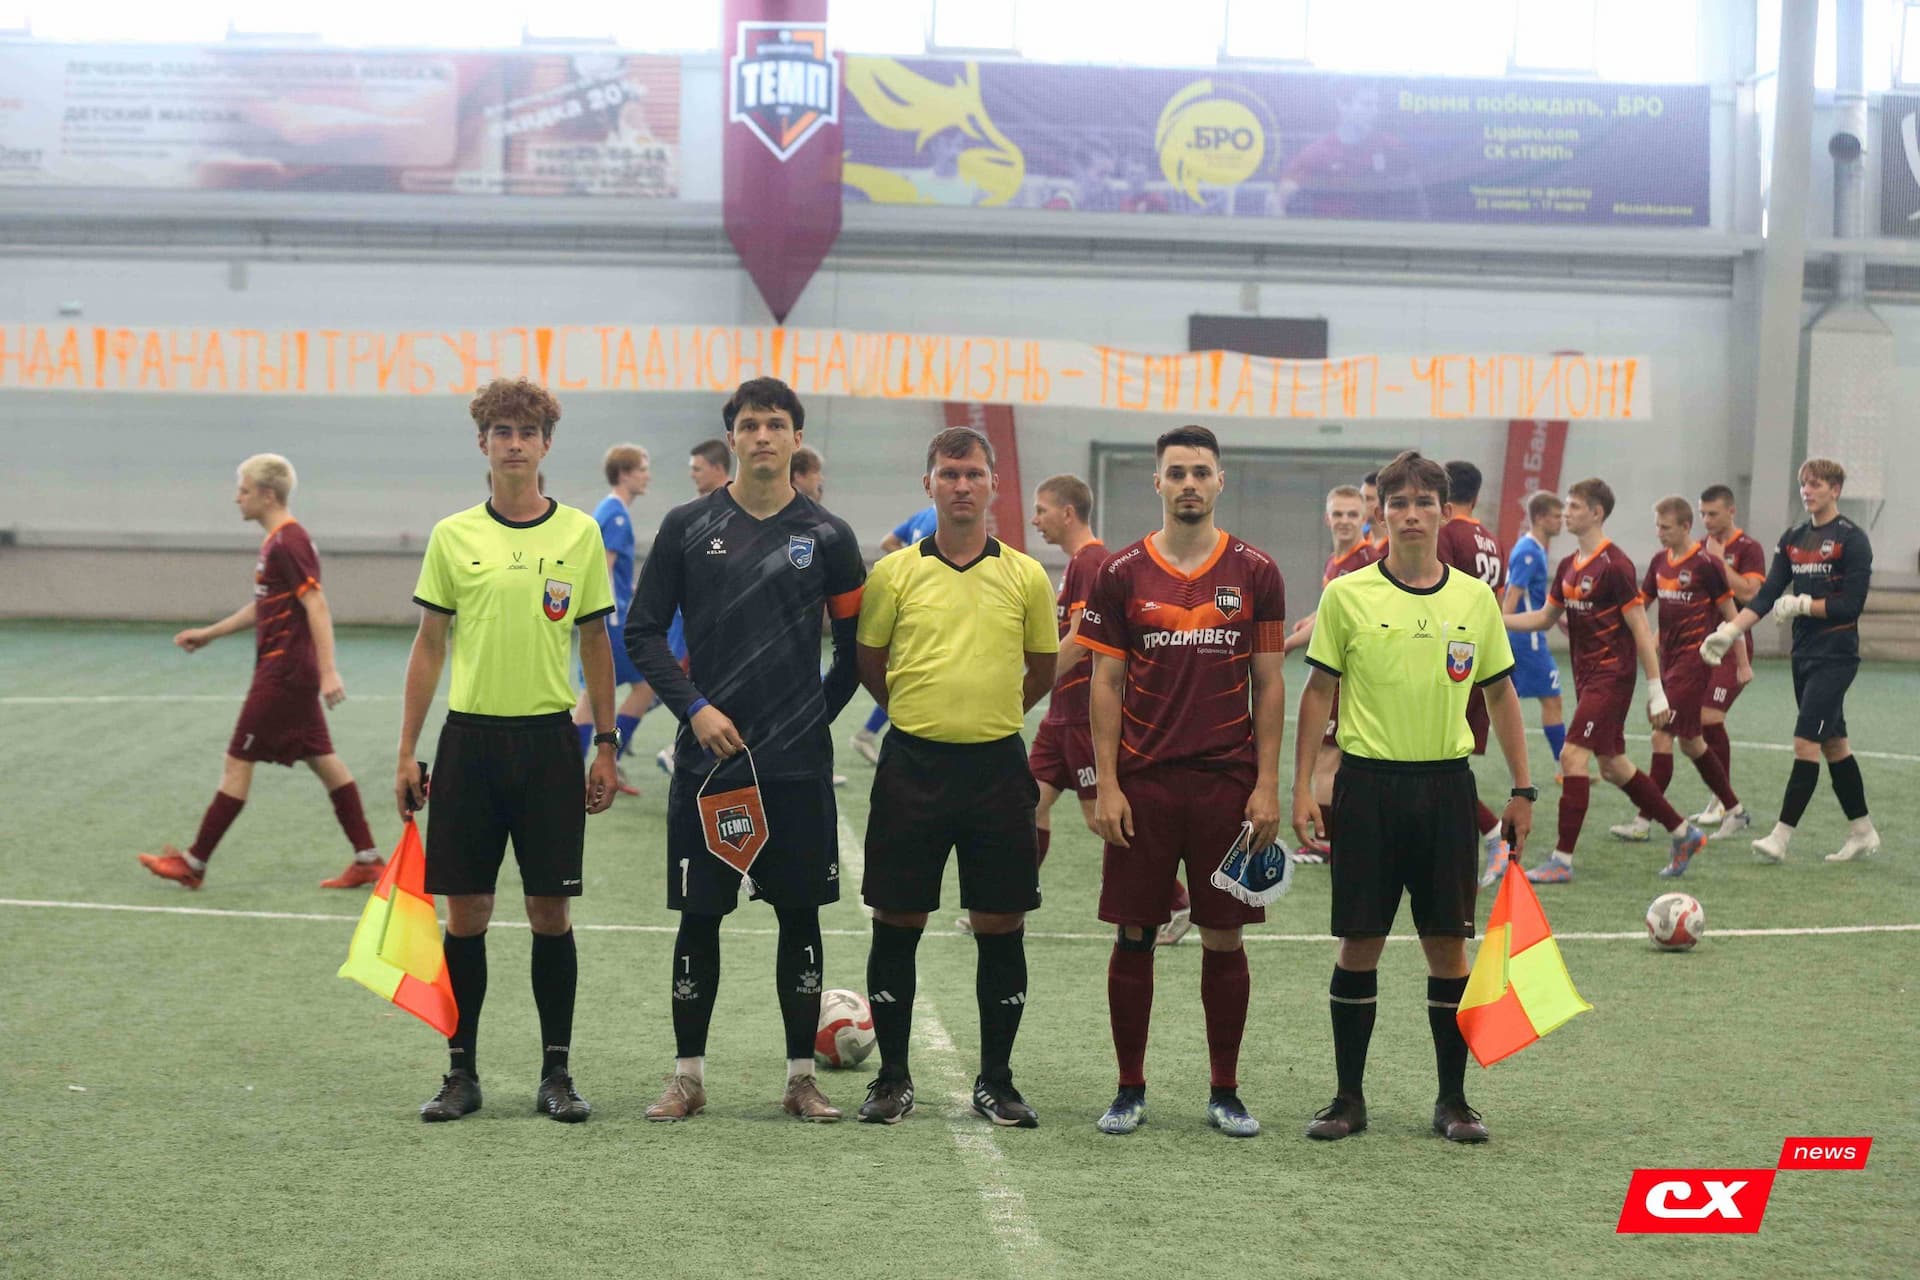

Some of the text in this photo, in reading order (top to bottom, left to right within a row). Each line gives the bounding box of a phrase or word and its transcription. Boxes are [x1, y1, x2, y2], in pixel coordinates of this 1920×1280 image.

[741, 60, 828, 108] ТЕМП
[1400, 91, 1469, 116] Время
[1484, 144, 1505, 159] СК
[1217, 595, 1240, 608] ТЕМП
[1143, 628, 1241, 650] ПРОДИНВЕСТ
[1077, 766, 1096, 787] 20
[720, 818, 750, 837] ТЕМП
[679, 858, 690, 897] 1
[681, 955, 690, 974] 1
[804, 945, 815, 964] 1
